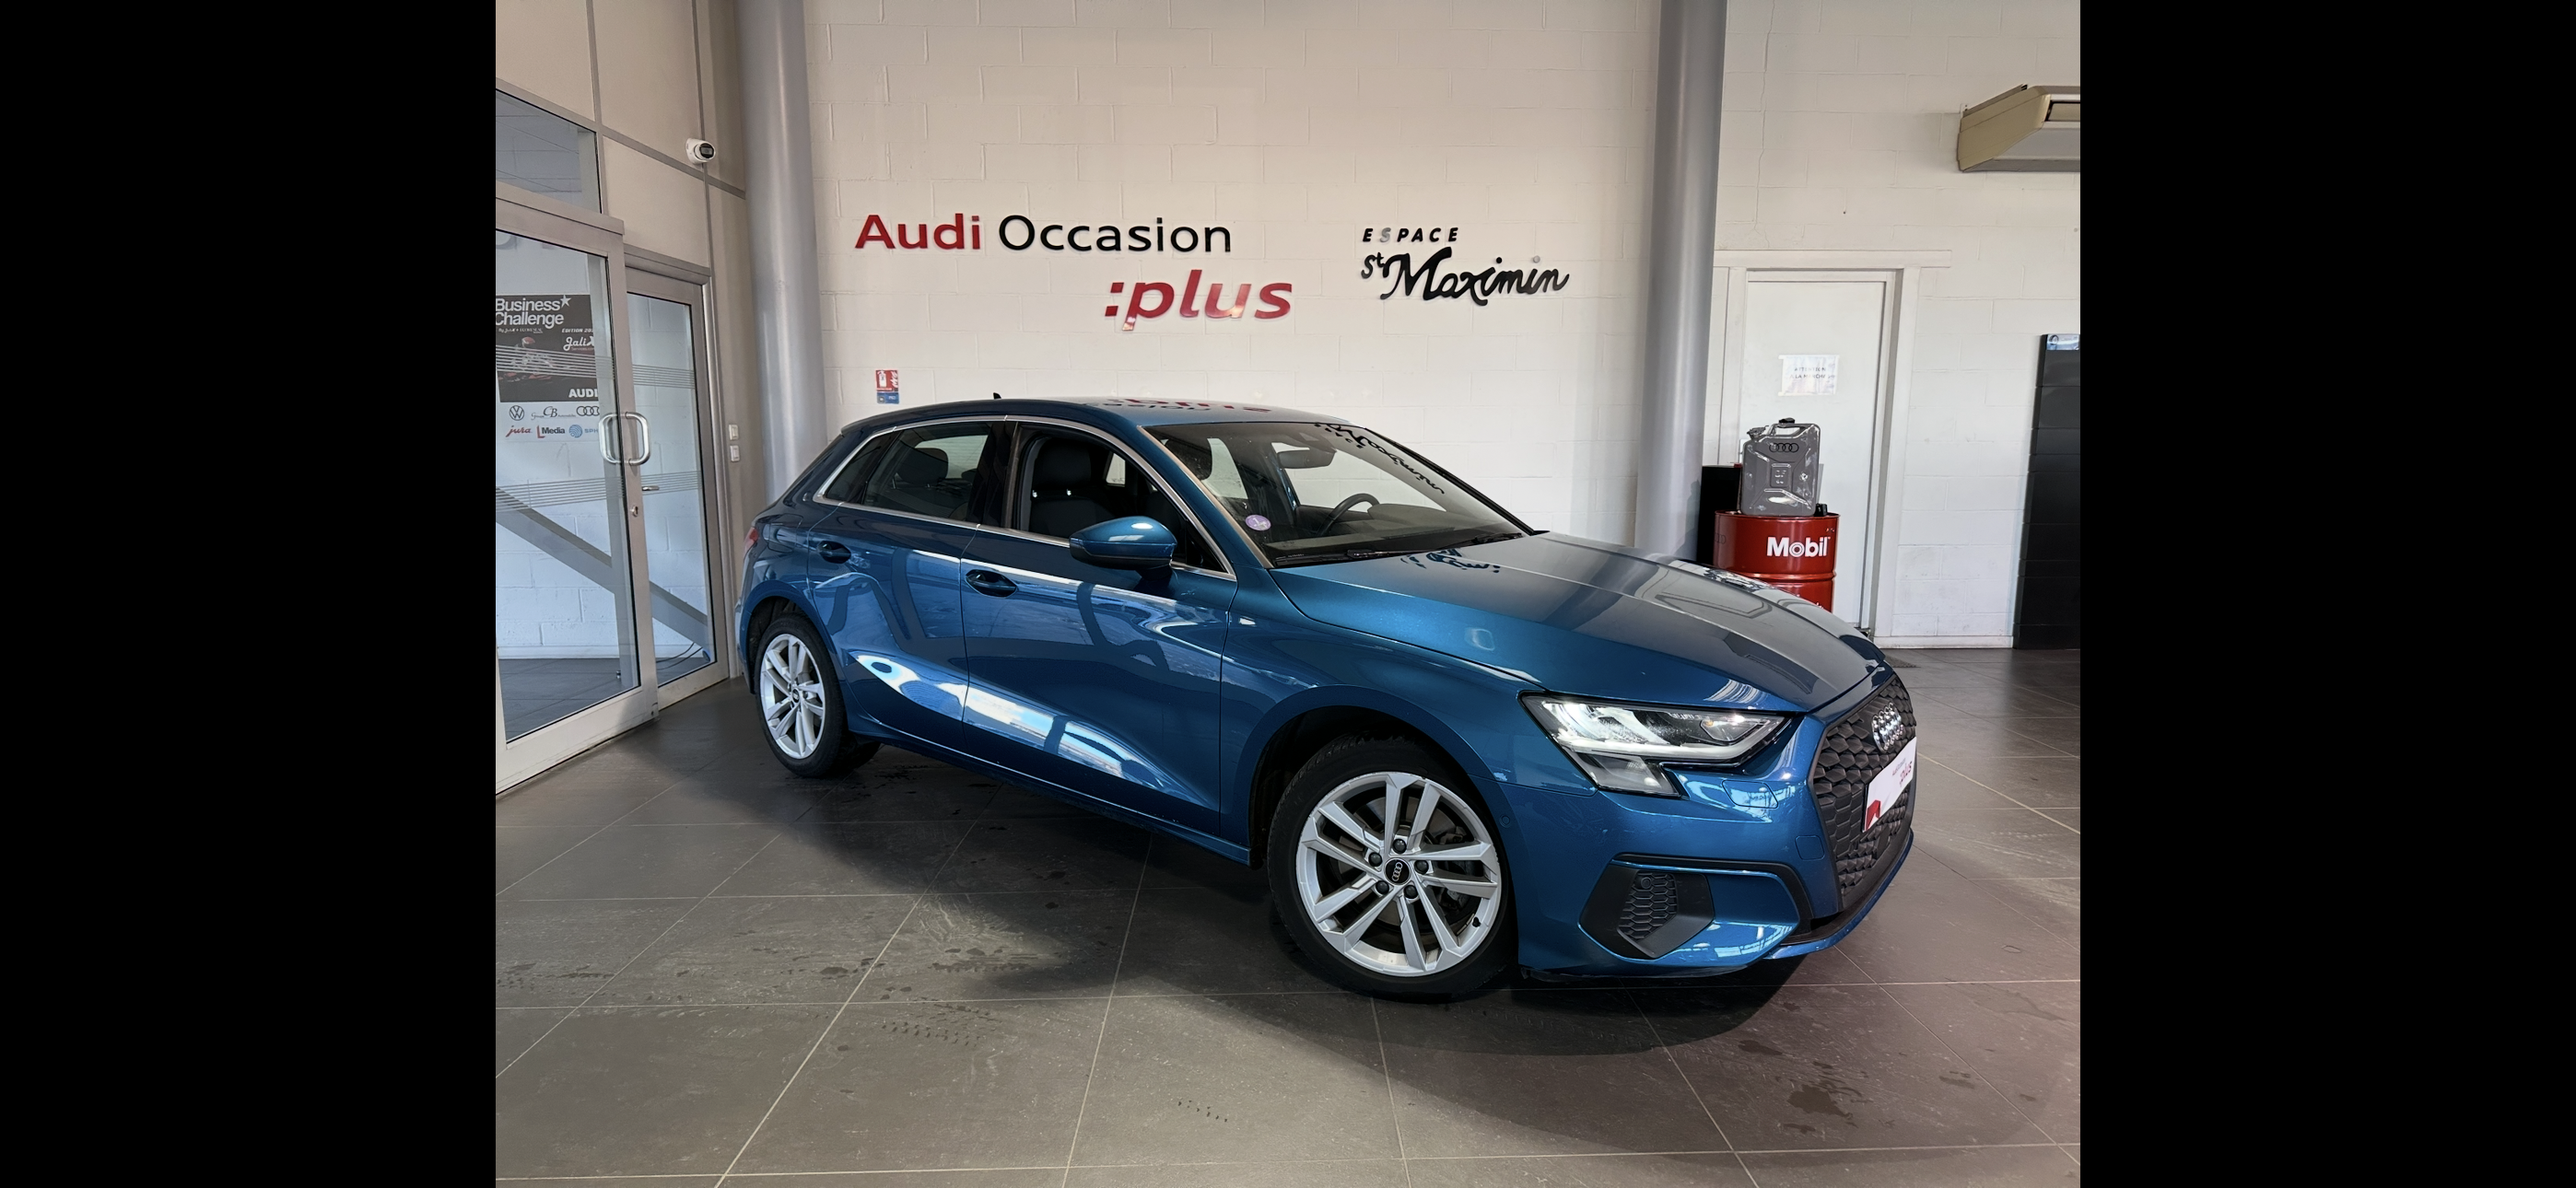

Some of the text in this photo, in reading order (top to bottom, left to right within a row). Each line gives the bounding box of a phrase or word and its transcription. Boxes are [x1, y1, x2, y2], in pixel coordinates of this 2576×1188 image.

[855, 213, 1231, 252] Audi Occasion
[1363, 227, 1458, 242] ESPACE
[1362, 247, 1570, 306] St Maximin
[496, 297, 560, 311] Business
[496, 312, 564, 329] Challenge
[568, 389, 598, 398] AUDI
[506, 425, 532, 437] jura
[1766, 537, 1828, 557] Mobil
